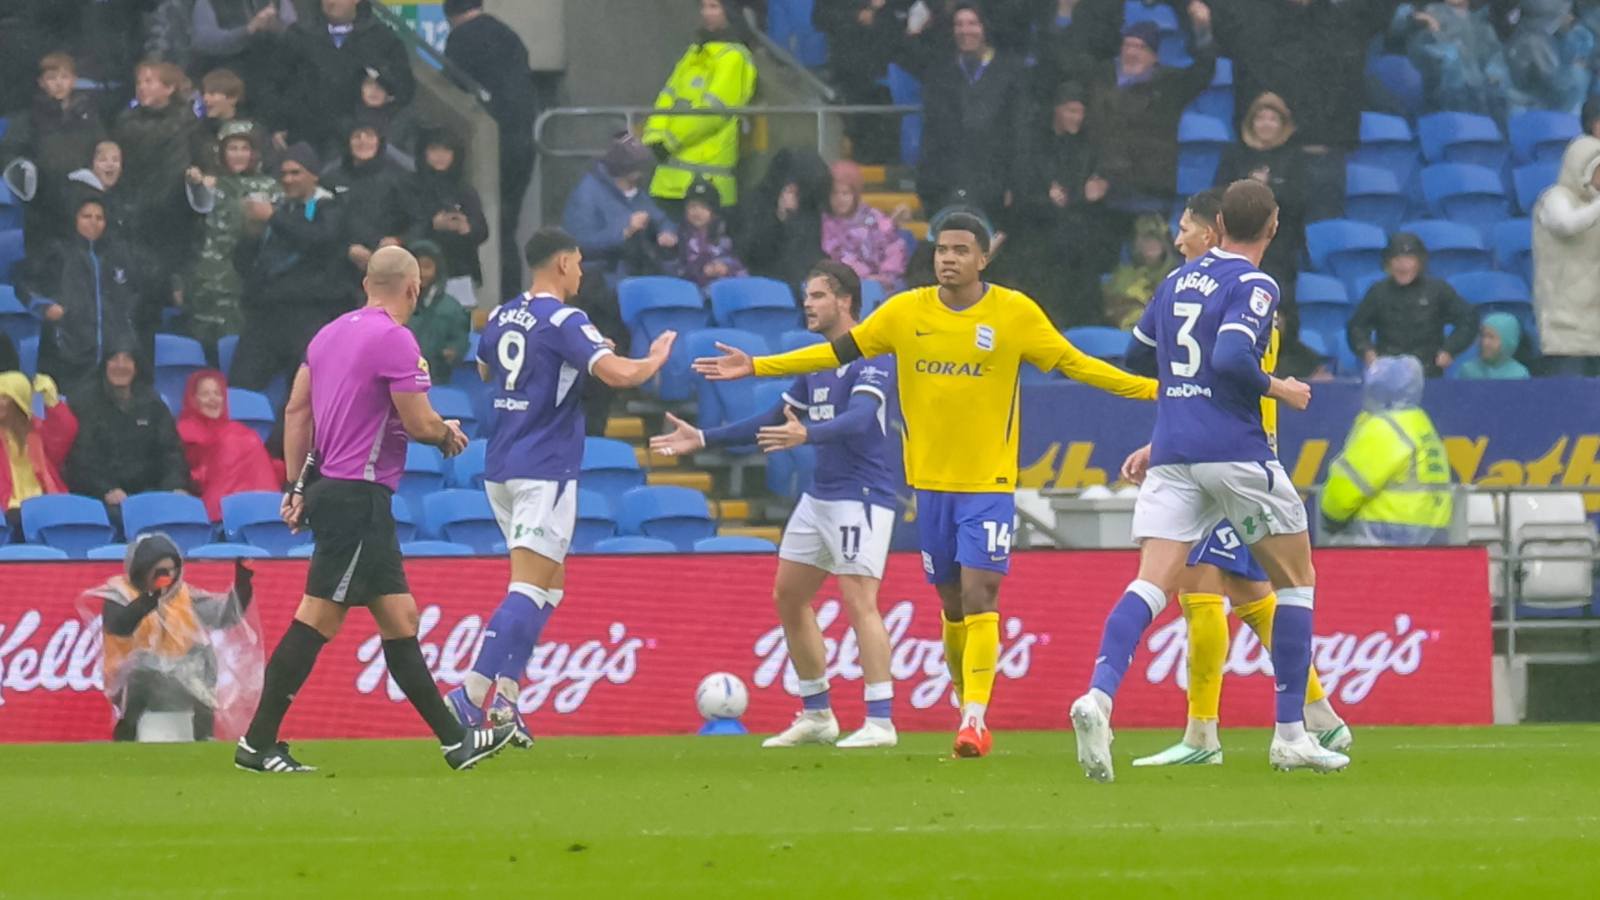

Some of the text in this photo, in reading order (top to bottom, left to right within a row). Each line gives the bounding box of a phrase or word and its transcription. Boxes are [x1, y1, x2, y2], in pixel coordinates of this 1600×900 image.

[1169, 302, 1203, 378] 3
[497, 330, 526, 391] 9
[915, 359, 984, 377] CORAL
[839, 525, 861, 553] 11
[982, 520, 1011, 555] 14
